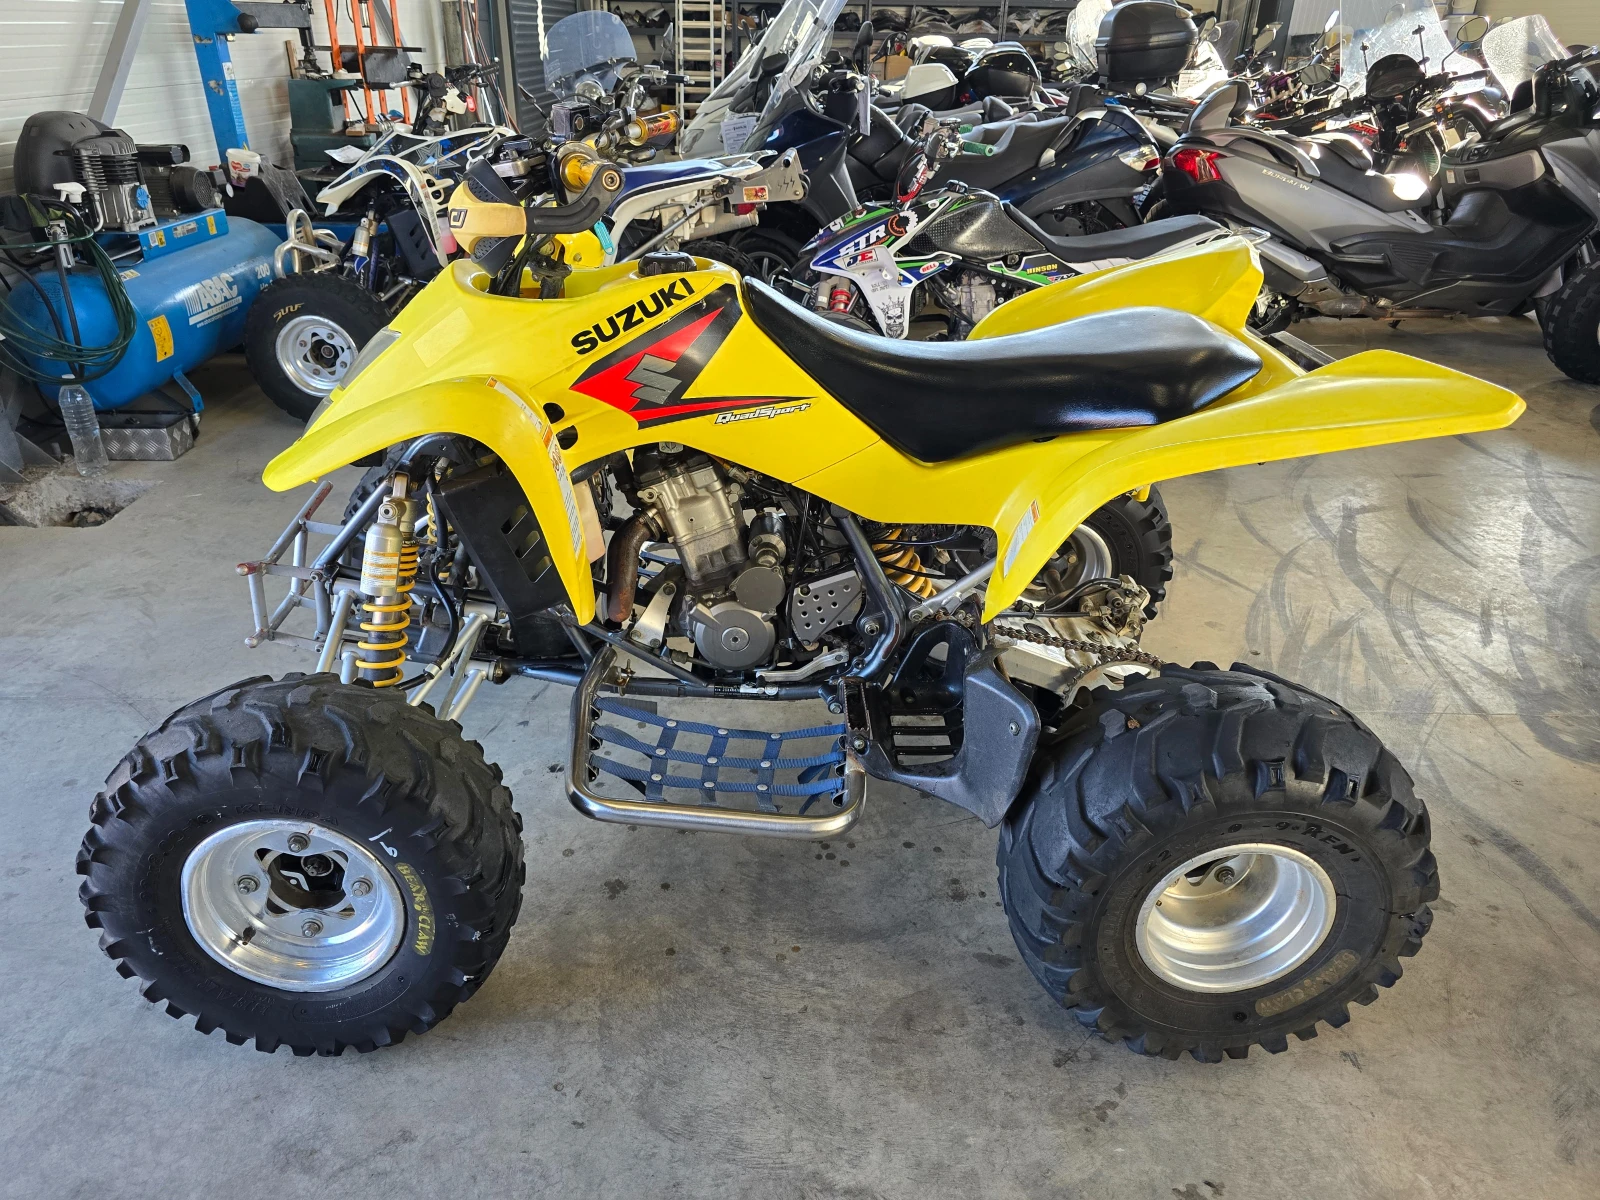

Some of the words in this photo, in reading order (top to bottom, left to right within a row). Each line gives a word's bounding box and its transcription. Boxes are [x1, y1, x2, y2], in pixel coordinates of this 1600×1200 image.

[845, 249, 874, 269] JE
[921, 262, 938, 274] BELL
[1026, 263, 1059, 275] HINSON
[255, 263, 271, 279] 200
[196, 272, 239, 311] ABAC
[571, 277, 696, 355] SUZUKI
[714, 403, 811, 426] QuadSport
[234, 802, 340, 827] KENDA
[397, 864, 428, 905] BEAR
[414, 914, 432, 956] CLAW
